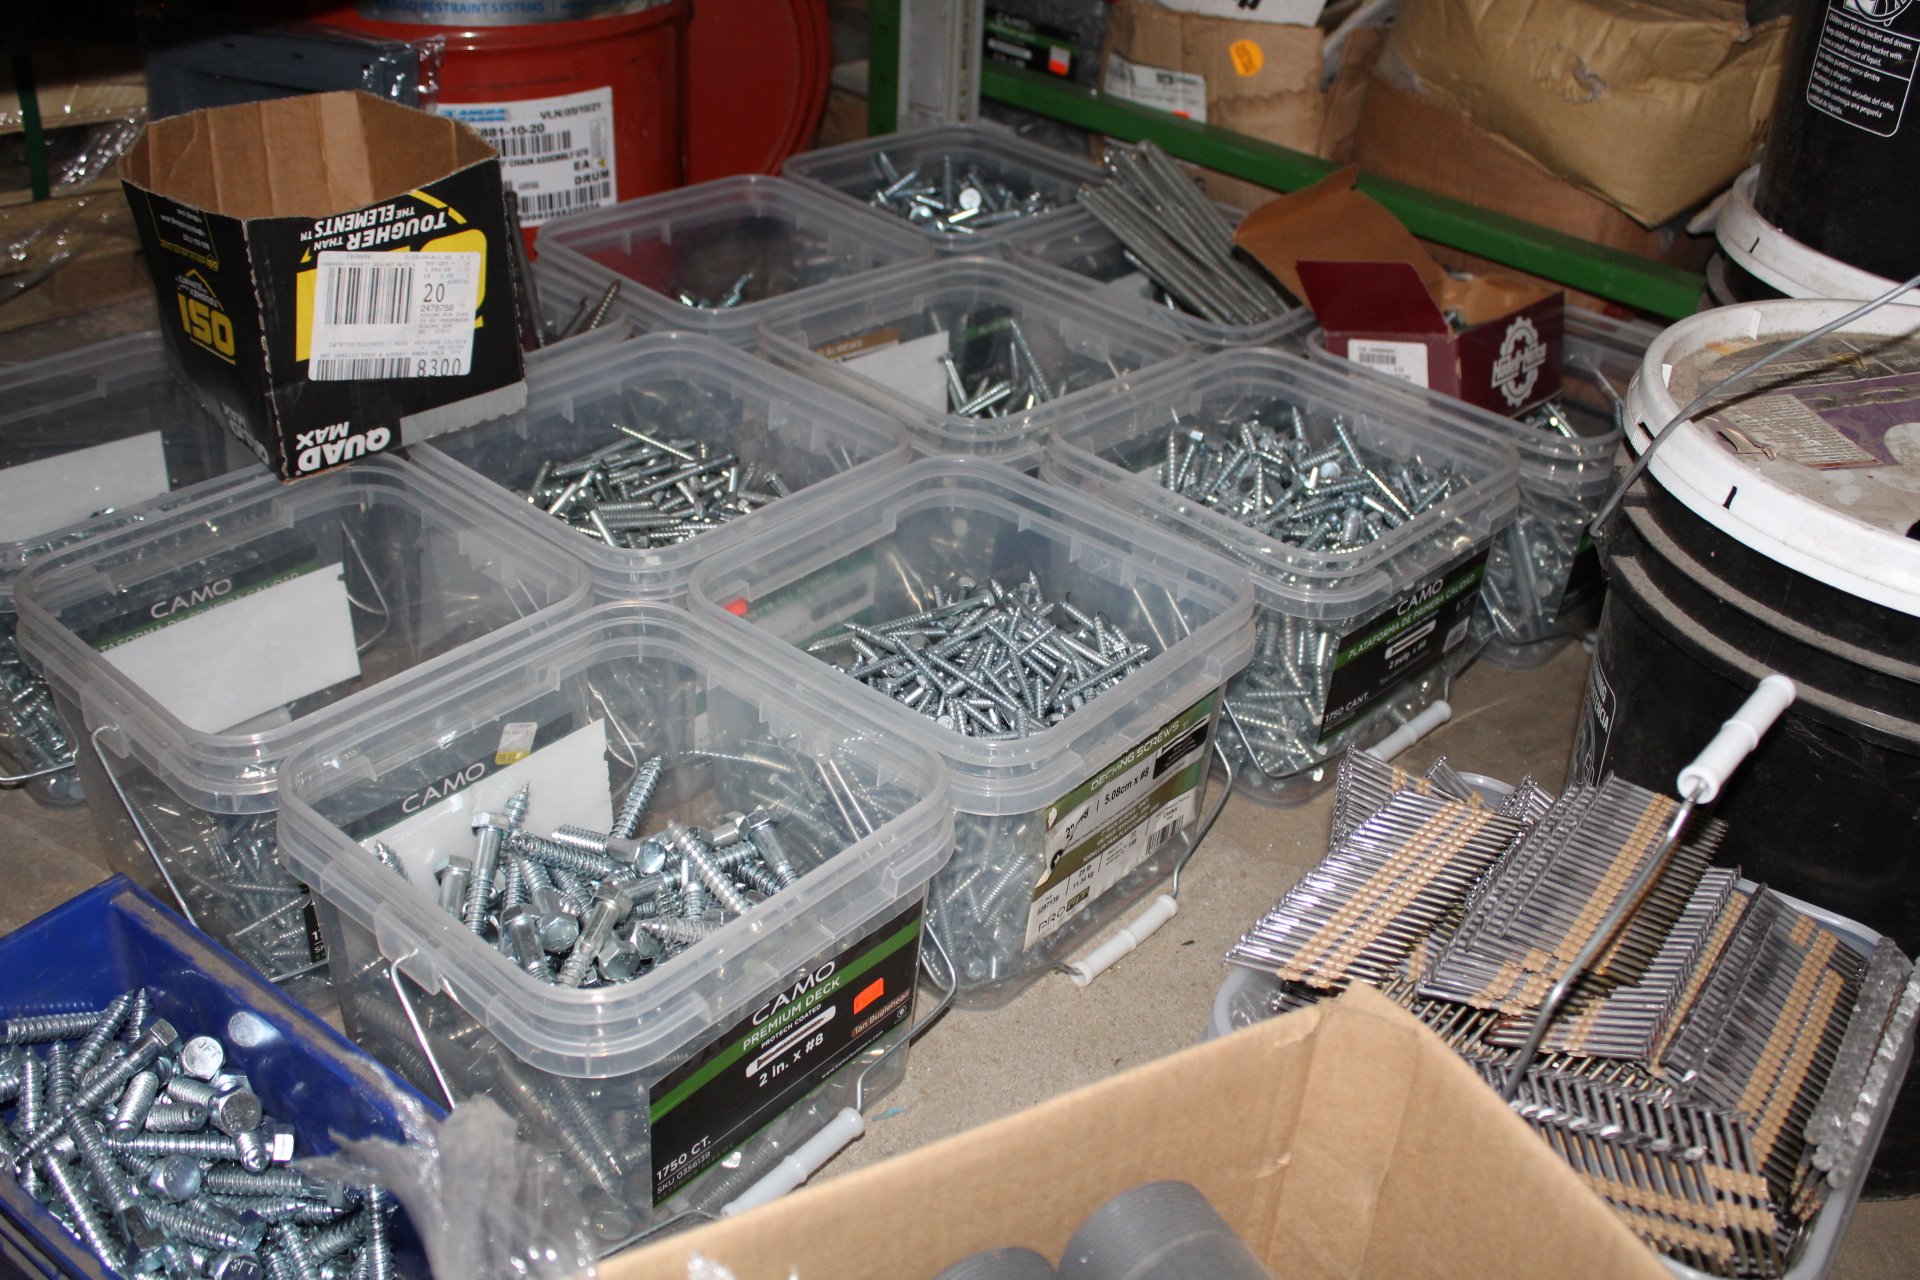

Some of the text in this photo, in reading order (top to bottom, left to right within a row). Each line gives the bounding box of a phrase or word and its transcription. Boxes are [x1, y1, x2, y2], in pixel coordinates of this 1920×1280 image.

[419, 1, 486, 14] RESTRAINT
[1861, 41, 1872, 50] from
[1872, 45, 1889, 56] bucket
[1890, 52, 1902, 60] with
[1867, 30, 1882, 41] bucket
[1894, 40, 1912, 50] drown.
[1864, 71, 1880, 82] dentro
[480, 123, 546, 137] 881-10-20
[509, 157, 534, 168] CHAIN
[573, 160, 590, 171] EA
[574, 170, 609, 186] DRUM
[313, 204, 395, 238] ELEMENTS
[395, 206, 415, 219] THE
[313, 210, 448, 251] TOUGHER THAN
[423, 283, 445, 303] 20
[177, 291, 235, 357] OSI
[416, 358, 462, 377] 8300
[295, 420, 349, 450] MAX
[299, 425, 391, 472] QUAD
[150, 578, 232, 619] CAMO
[1397, 578, 1443, 616] CAMO
[1348, 622, 1400, 659] PLATAFORMA
[1401, 614, 1411, 627] DE
[1412, 596, 1445, 620] PRIMERA
[1325, 706, 1344, 723] 1750
[1345, 691, 1369, 710] CANT.
[1136, 720, 1180, 757] SCREWS
[402, 761, 486, 816] CAMO
[1104, 780, 1133, 805] 5.08cm
[752, 961, 835, 1026] CAMO
[742, 976, 840, 1051] PREMIUM DECK
[760, 1004, 822, 1049] PROTECH COATED
[852, 991, 910, 1036] Tan Buglehead
[759, 1033, 825, 1087] 2 in. x #8
[656, 1136, 712, 1180] 1750 CT.
[656, 1151, 712, 1195] SKU 0356139
